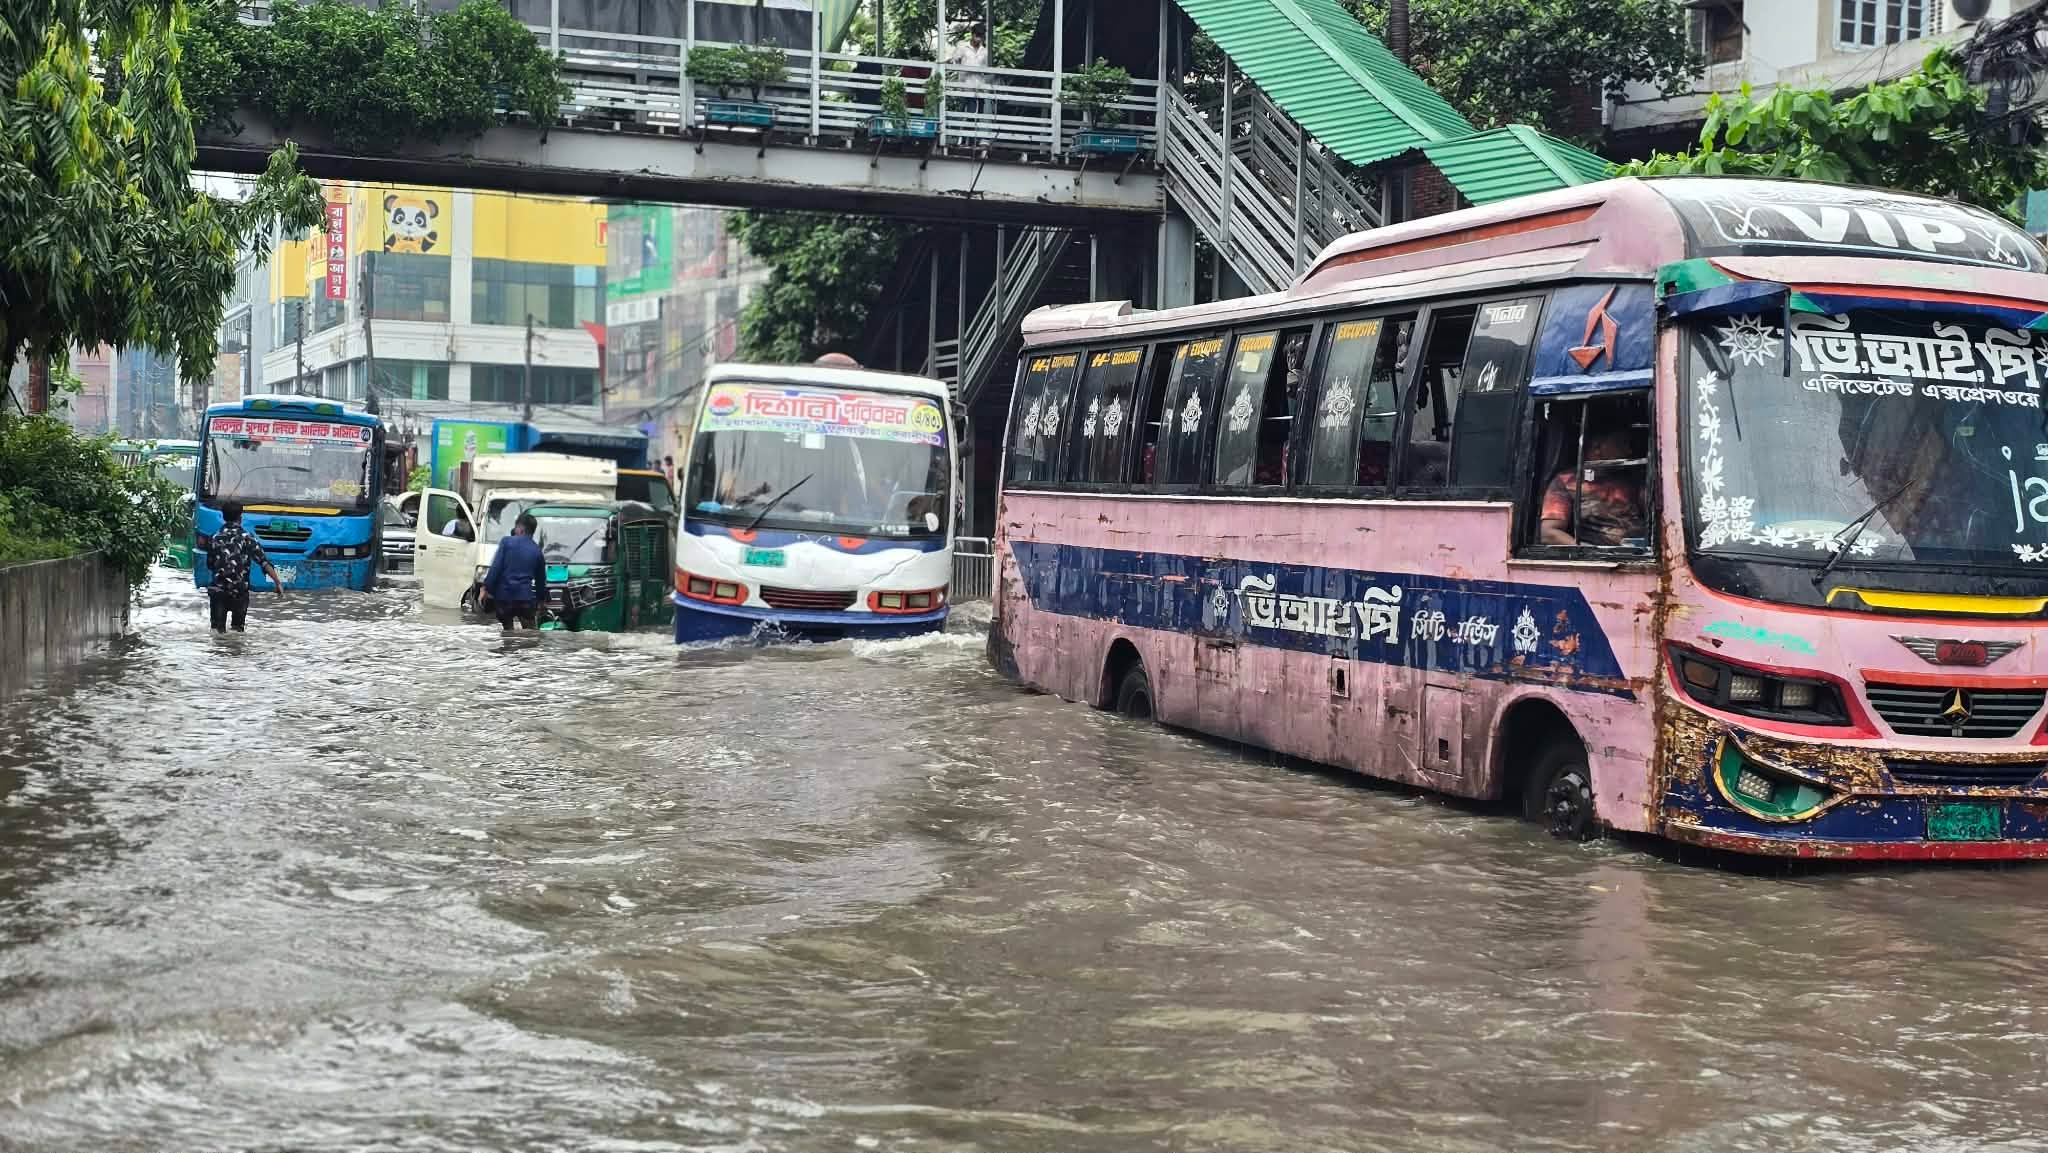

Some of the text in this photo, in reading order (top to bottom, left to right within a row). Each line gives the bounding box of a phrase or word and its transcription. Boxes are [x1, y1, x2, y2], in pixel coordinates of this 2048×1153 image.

[1767, 205, 1966, 252] VIP
[1337, 320, 1380, 341] EXCLUSIVE
[1111, 350, 1140, 365] EXCLUSIVE
[1802, 374, 2041, 408] এলিভেটেড এক্সপ্রেসওয়ে
[744, 392, 908, 425] দিশারী পরিবহন
[211, 418, 244, 434] মিরপুর
[245, 421, 269, 435] সুপার
[300, 423, 330, 437] মালিক
[1410, 609, 1446, 641] সিটি
[1447, 615, 1500, 648] ার্ভিস
